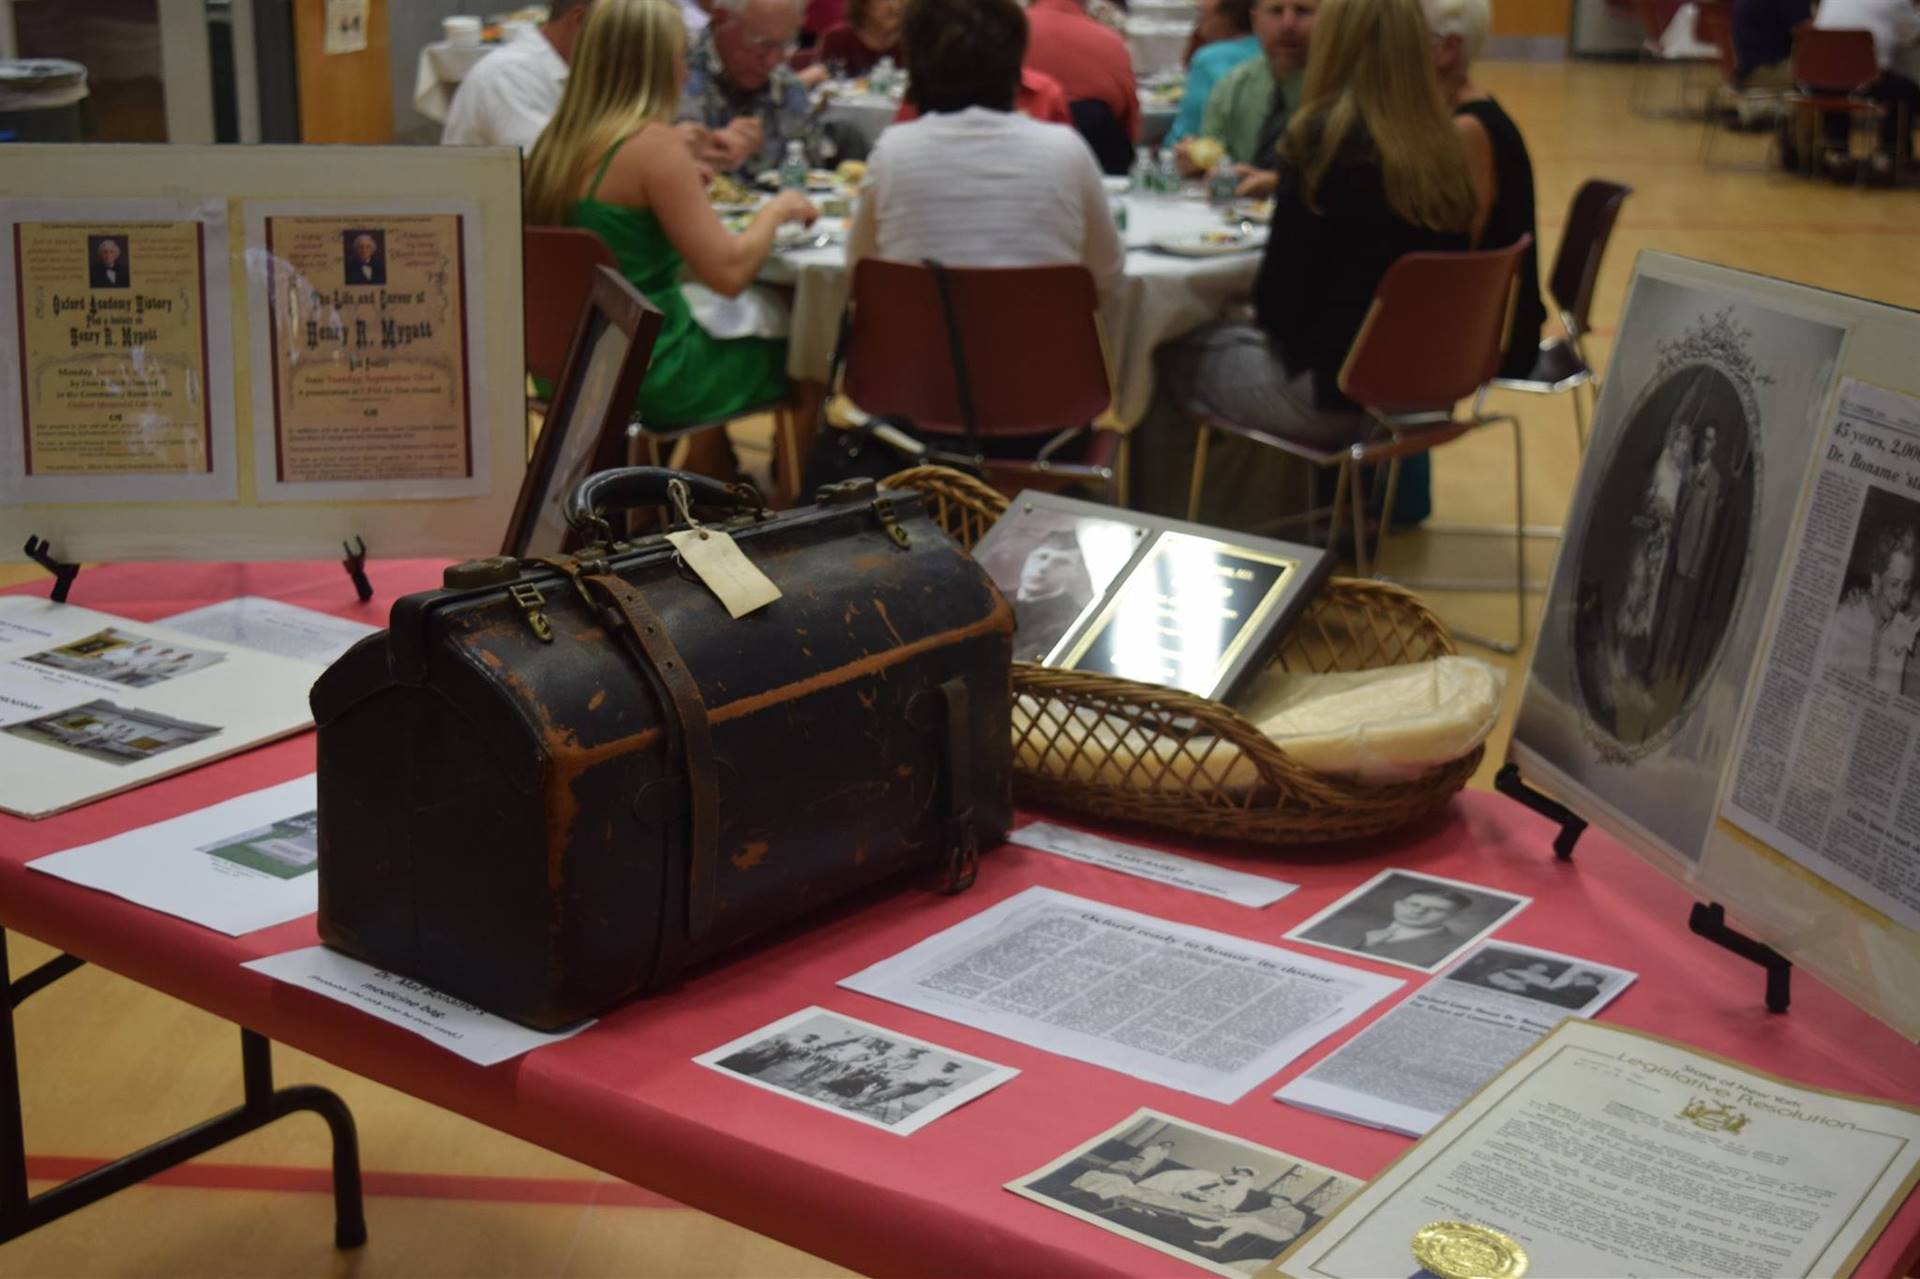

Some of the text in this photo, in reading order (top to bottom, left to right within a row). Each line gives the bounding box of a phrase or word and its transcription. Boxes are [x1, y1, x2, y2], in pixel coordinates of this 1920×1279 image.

[89, 292, 132, 315] Academy
[134, 293, 173, 315] History
[357, 290, 375, 304] and
[379, 288, 413, 310] Career
[415, 290, 426, 304] of
[70, 325, 158, 348] Henry R. Mygatt
[306, 316, 433, 351] Henry R. Mygatt
[1834, 421, 1851, 438] 45
[1849, 430, 1886, 453] years,
[1826, 444, 1845, 464] Dr.
[1848, 451, 1900, 483] Boname
[1081, 912, 1334, 983] Oxford ready to honor its doctor
[1616, 1051, 1732, 1098] Legislative
[1736, 1092, 1857, 1132] Resolution
[1682, 1063, 1802, 1109] State of New York
